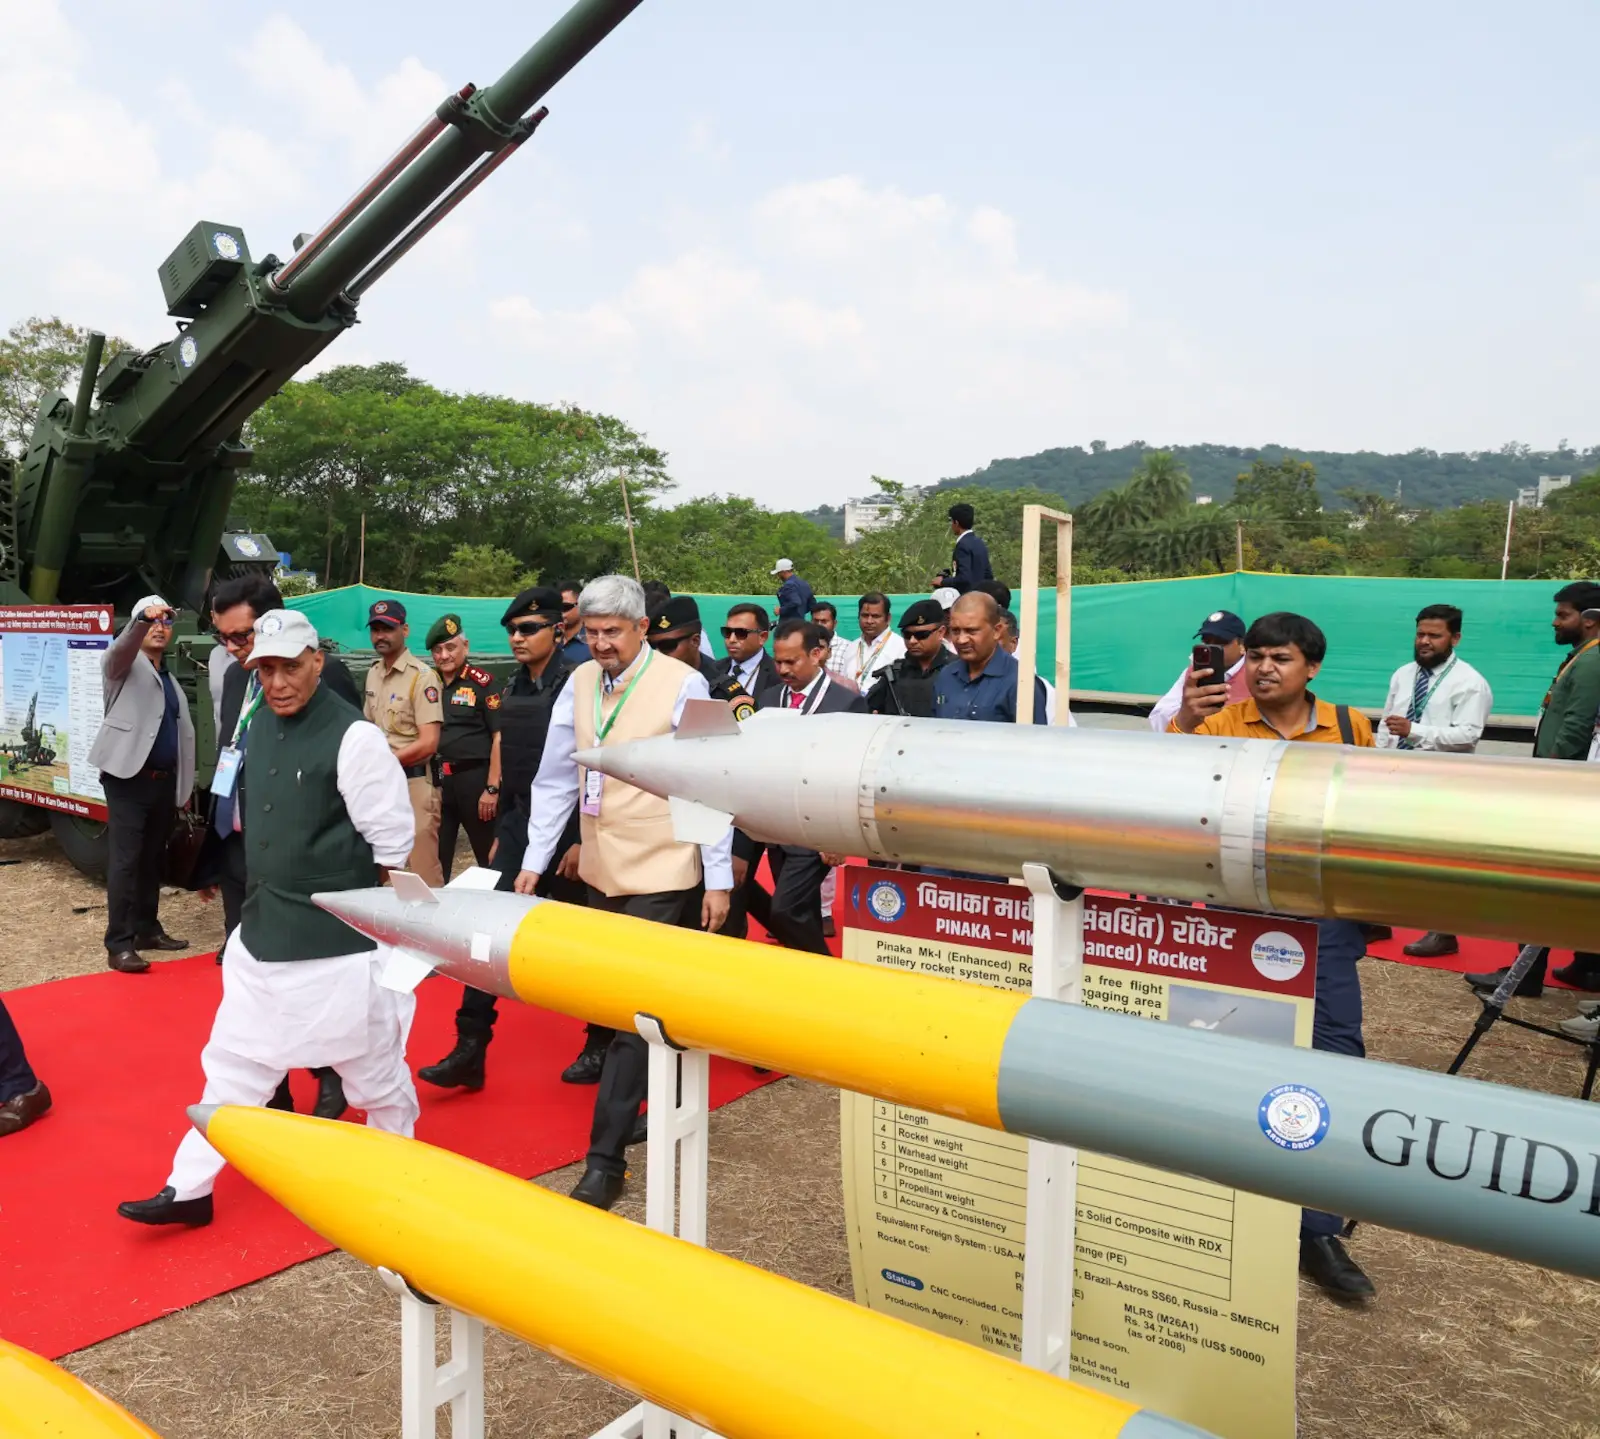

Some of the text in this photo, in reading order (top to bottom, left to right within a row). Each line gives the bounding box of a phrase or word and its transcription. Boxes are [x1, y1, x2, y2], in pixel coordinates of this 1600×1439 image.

[916, 882, 990, 916] पिनाका
[1170, 915, 1237, 950] रॉकेट
[936, 918, 992, 940] PINAKA
[1083, 940, 1142, 966] anced)
[1148, 948, 1208, 973] Rocket
[876, 954, 916, 970] artillery
[920, 962, 955, 974] rocket
[960, 968, 1000, 982] system
[1005, 976, 1032, 988] capa
[1082, 988, 1129, 1006] ngaging
[1134, 996, 1162, 1008] area
[877, 940, 912, 954] Pinaka
[948, 951, 1012, 972] (Enhanced)
[1084, 975, 1091, 983] a
[1099, 975, 1122, 988] free
[1130, 980, 1163, 994] flight
[881, 1107, 929, 1126] 3 Length
[880, 1124, 964, 1152] 4 Rocket weight
[881, 1142, 968, 1170] 5 Warhead weight
[881, 1158, 943, 1181] 6 Propellant
[882, 1175, 976, 1207] 7 Propellant weight
[883, 1191, 1007, 1233] 8 Accuracy & Consistency
[877, 1231, 930, 1253] Rocket Cost:
[1086, 1210, 1112, 1225] Solid
[1114, 1217, 1170, 1240] Composite
[1173, 1232, 1195, 1246] with
[1198, 1238, 1223, 1253] RDX
[1075, 1244, 1128, 1266] range (PE)
[876, 1212, 919, 1232] Equivalent
[920, 1226, 952, 1241] Foreign
[955, 1235, 986, 1250] System
[1183, 1298, 1218, 1318] Russia
[1230, 1312, 1280, 1334] SMERCH
[886, 1271, 916, 1287] Status
[884, 1294, 930, 1313] Production
[932, 1308, 964, 1324] Agency
[930, 1284, 949, 1296] CNC
[1103, 1339, 1130, 1354] soon.
[1124, 1303, 1199, 1334] MLRS (M26A1)
[1124, 1316, 1266, 1366] Rs. 34.7 Lakhs (US$ 50000)
[1128, 1328, 1186, 1354] (as of 2008)
[1082, 1356, 1097, 1368] Ltd
[1100, 1362, 1118, 1375] and
[1114, 1377, 1130, 1389] Ltd
